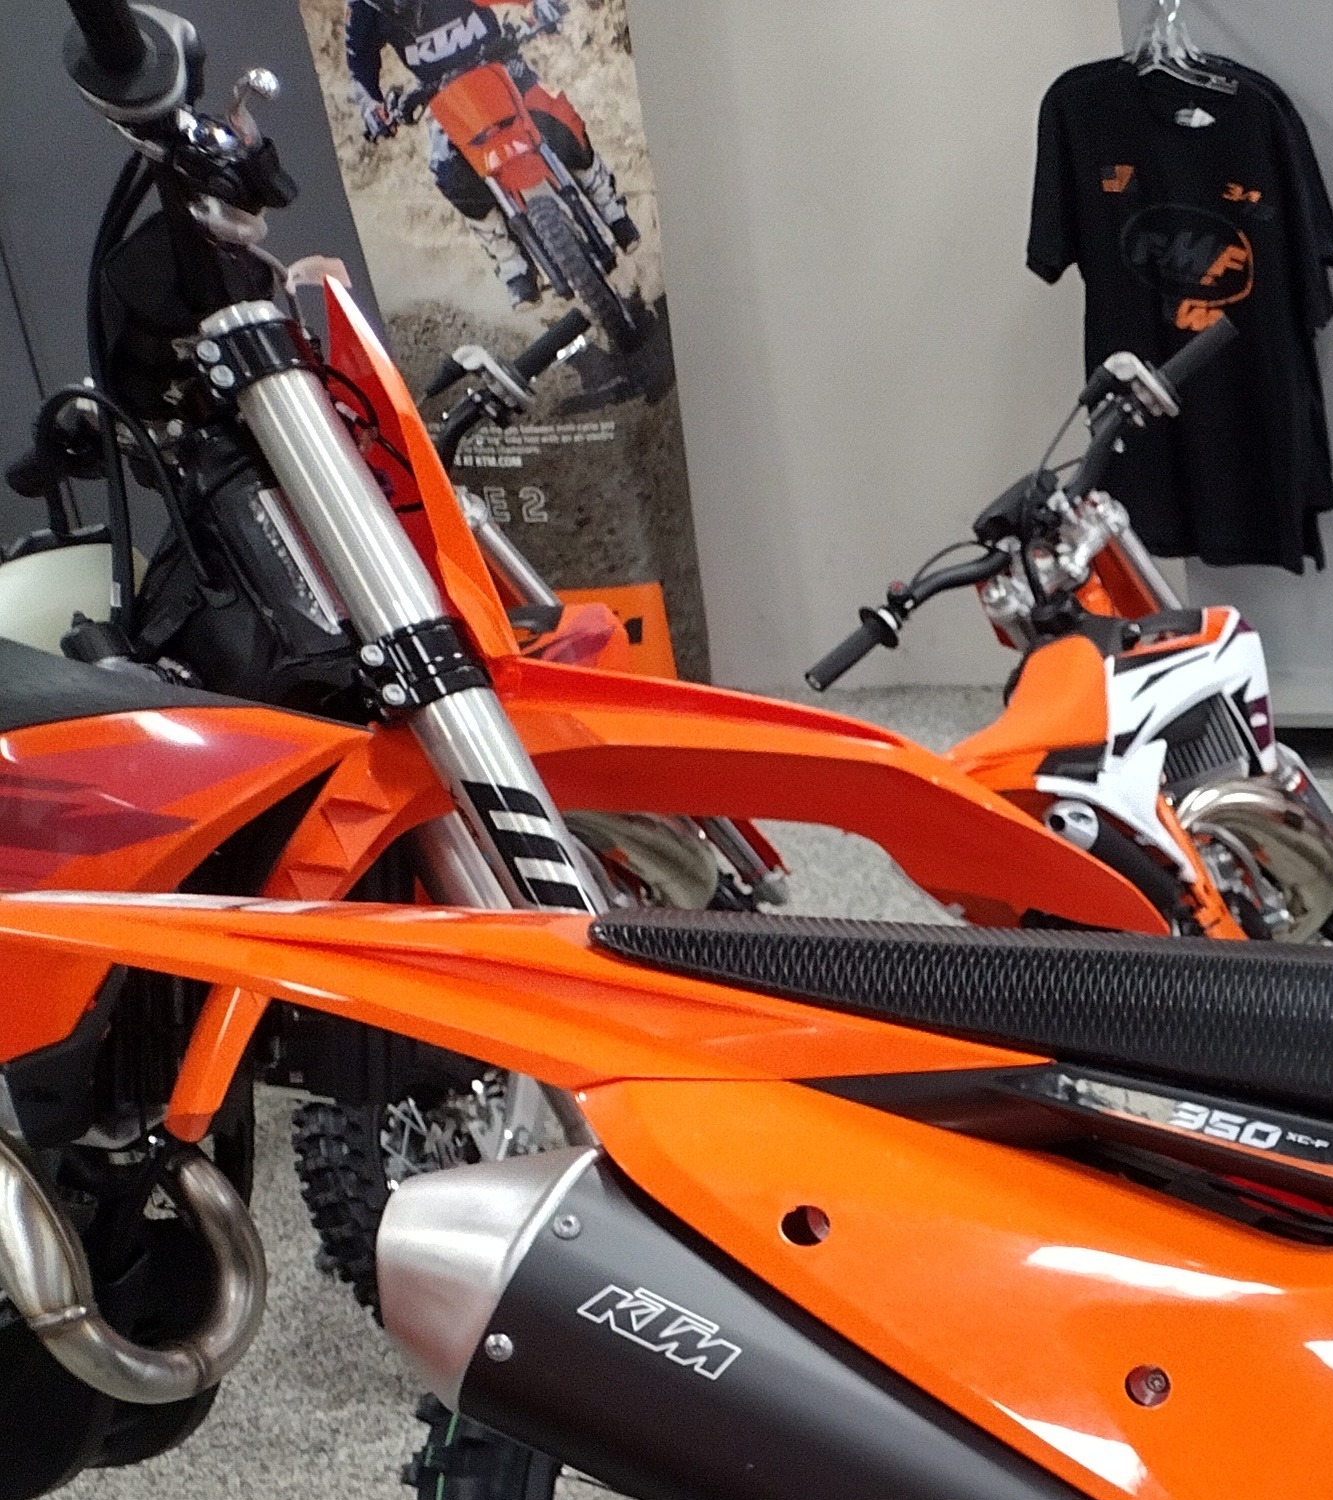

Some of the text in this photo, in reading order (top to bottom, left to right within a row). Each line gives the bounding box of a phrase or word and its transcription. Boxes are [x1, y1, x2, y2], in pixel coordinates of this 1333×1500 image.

[405, 10, 488, 66] KTM
[519, 485, 549, 523] 2
[1170, 1102, 1281, 1149] 350
[576, 1284, 743, 1381] KTM
